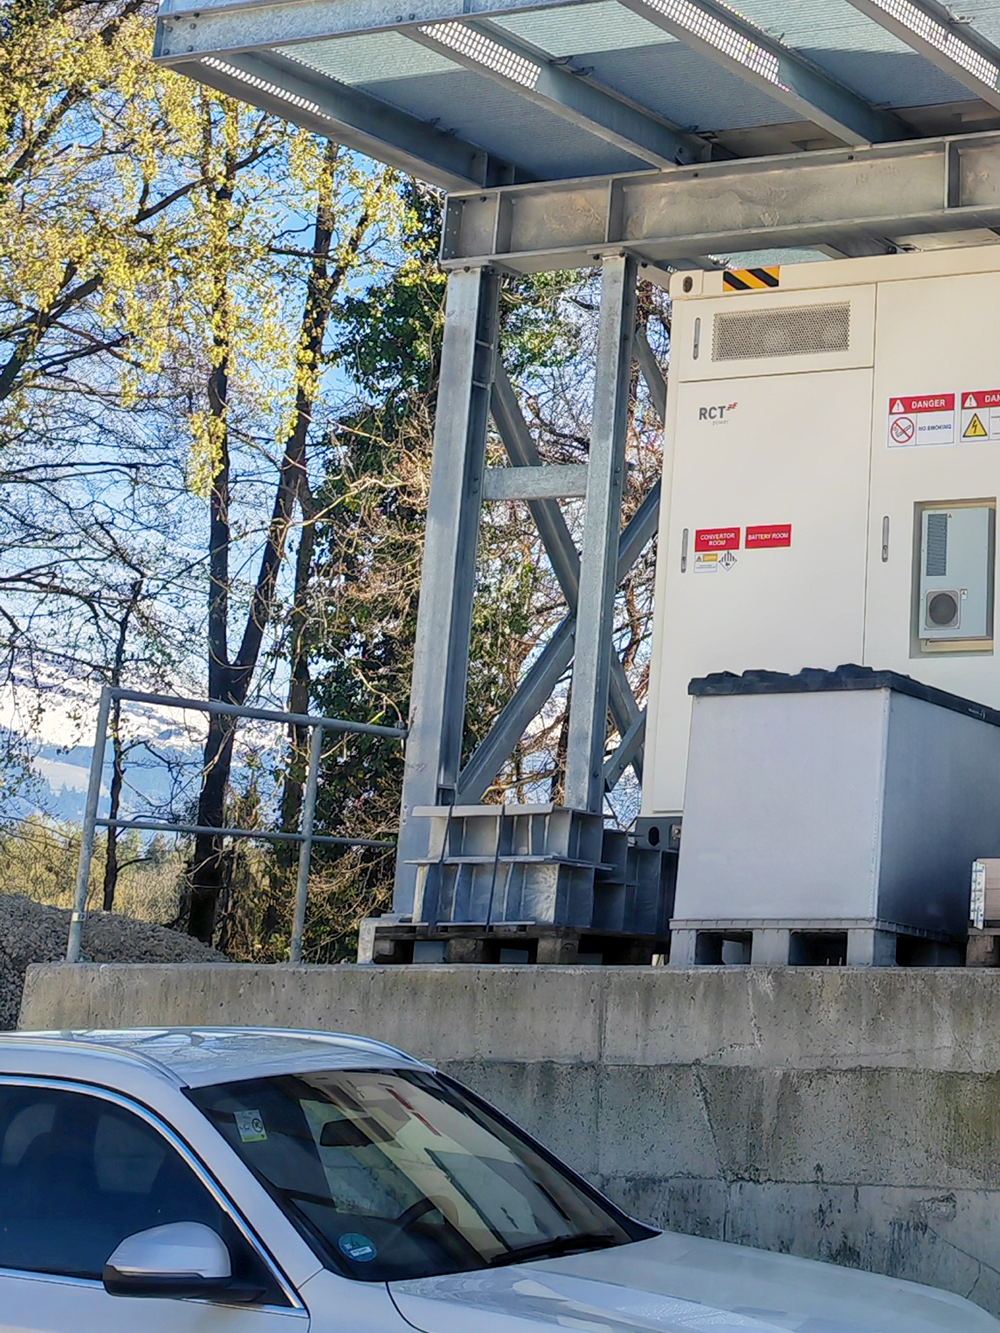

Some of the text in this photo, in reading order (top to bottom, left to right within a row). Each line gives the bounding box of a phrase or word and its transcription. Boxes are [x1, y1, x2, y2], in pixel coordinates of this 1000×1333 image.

[911, 399, 946, 409] DANGER
[699, 405, 726, 420] RCT
[700, 532, 736, 541] CONVERTOR
[747, 533, 771, 541] BATTERY
